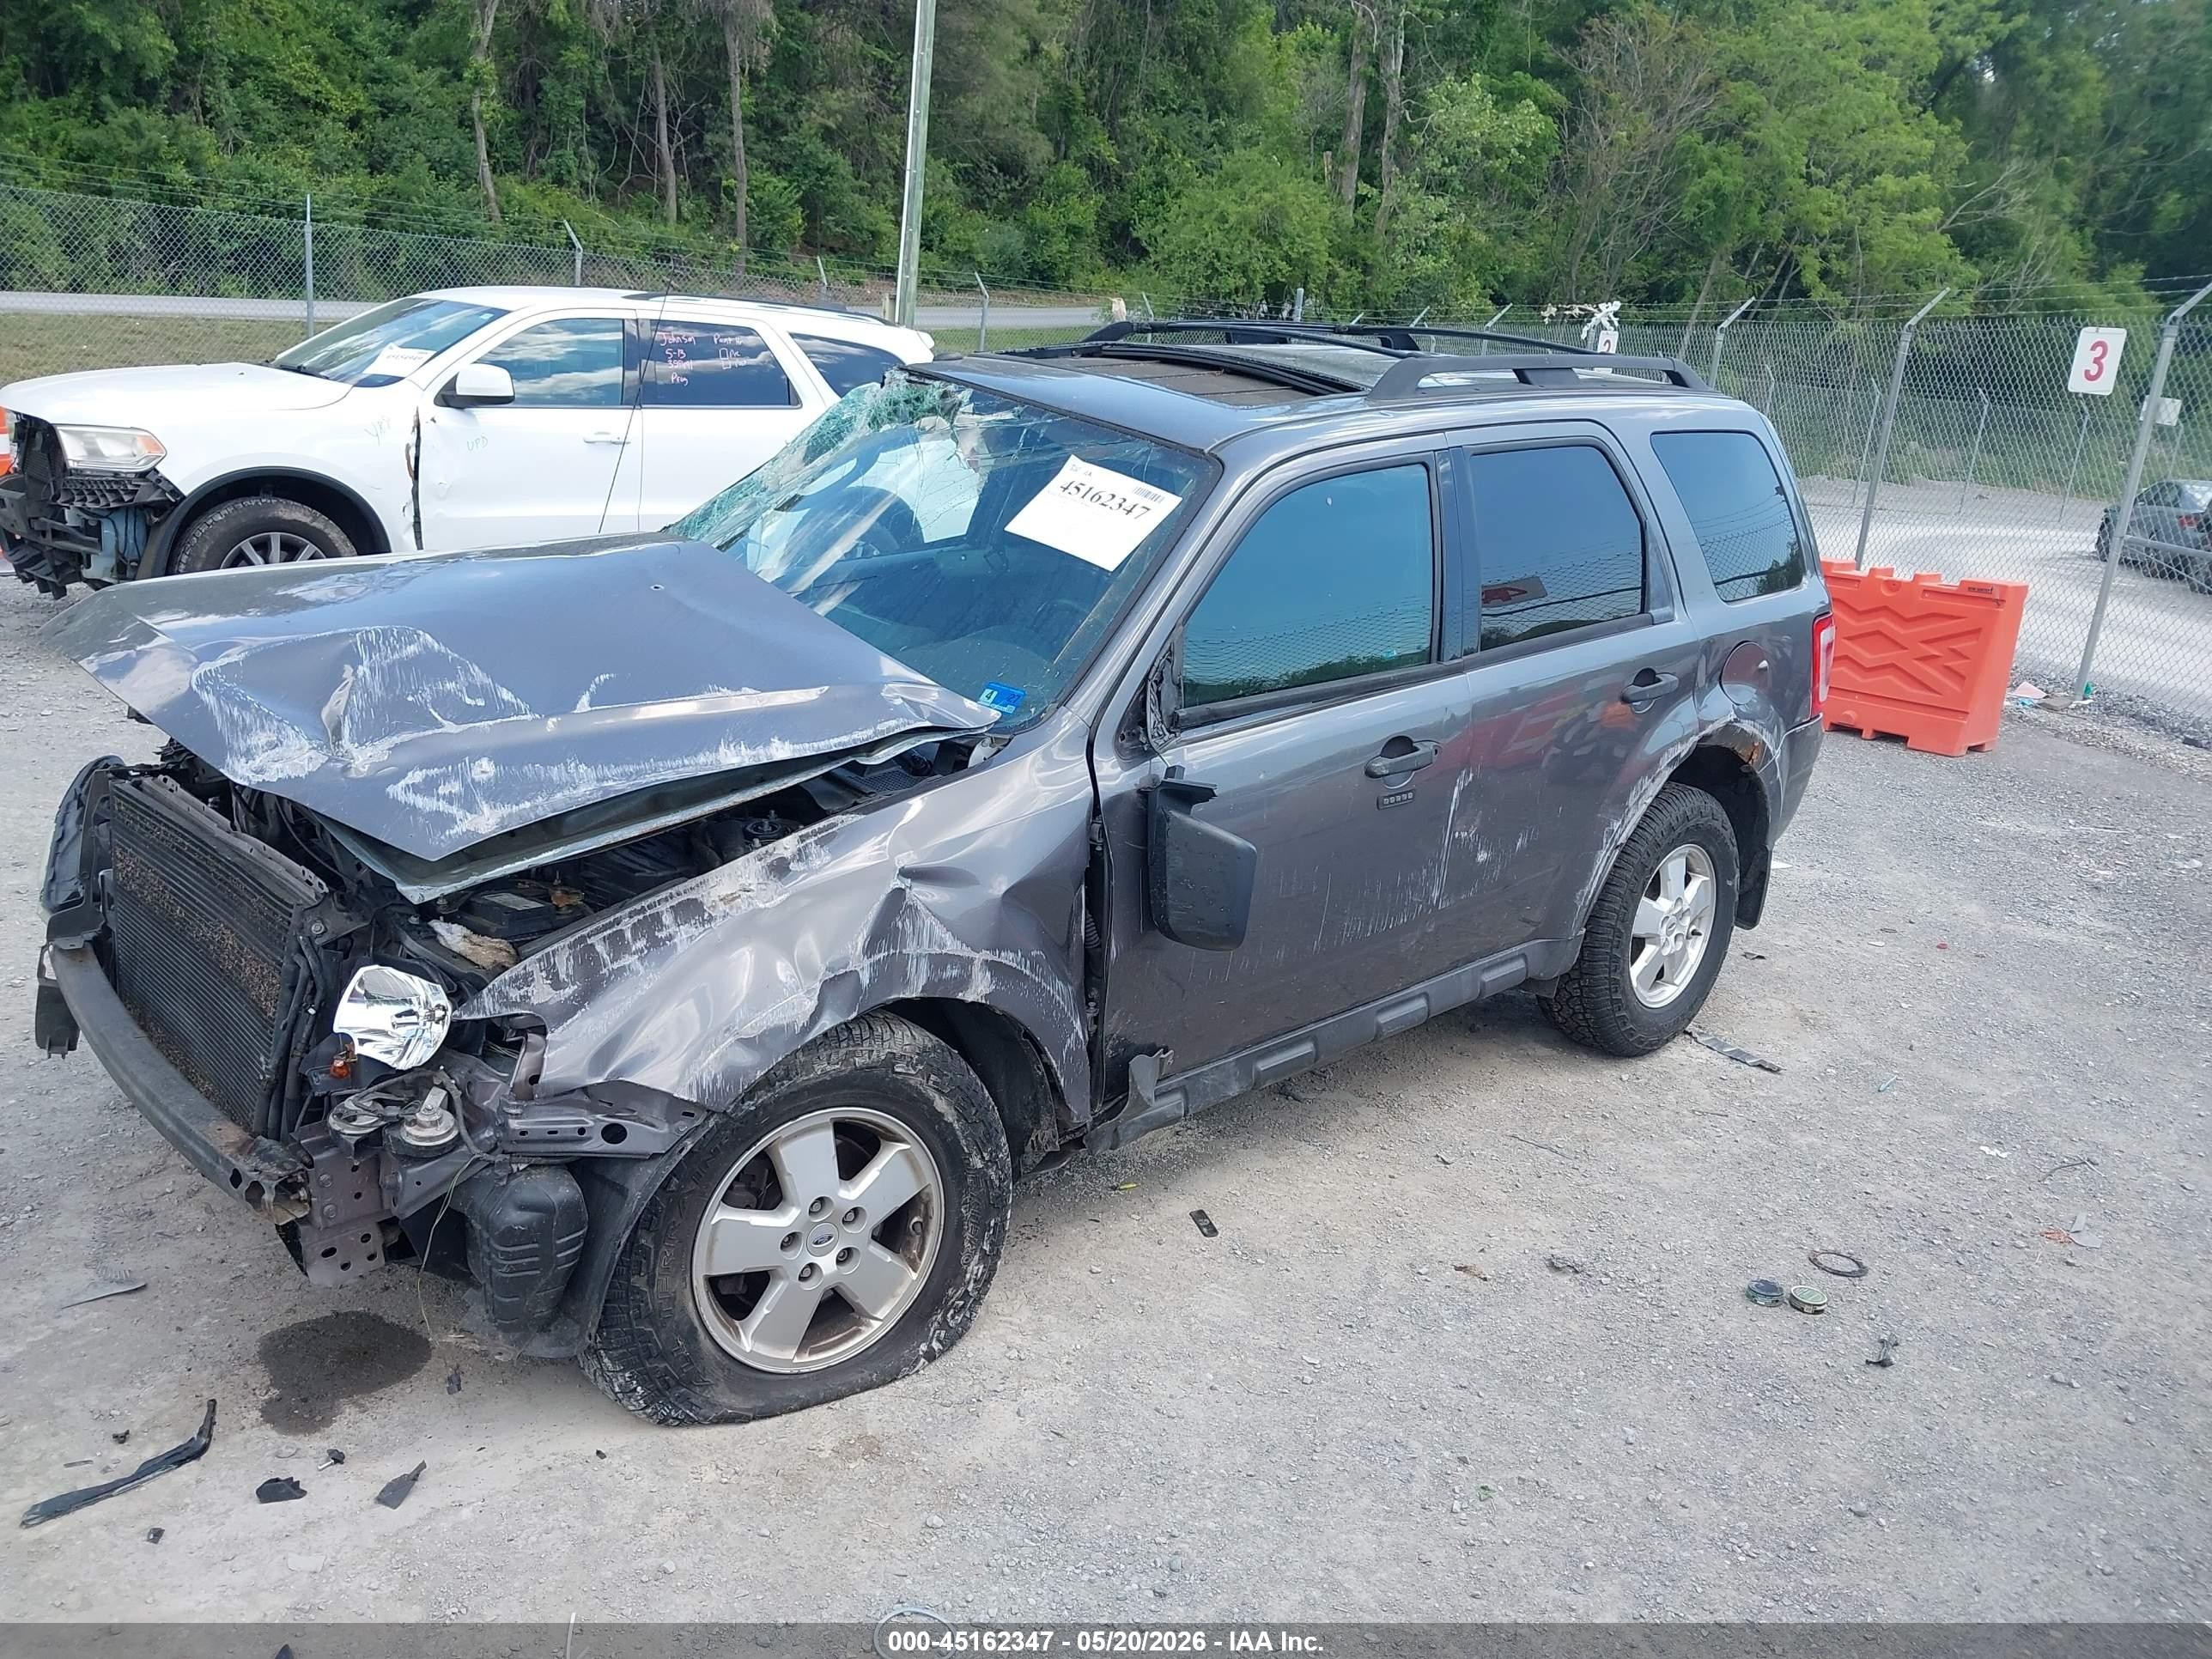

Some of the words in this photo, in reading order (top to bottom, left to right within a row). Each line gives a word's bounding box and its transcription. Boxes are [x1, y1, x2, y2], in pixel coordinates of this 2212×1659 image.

[659, 331, 696, 346] Johnson
[2084, 341, 2109, 382] 3
[1060, 479, 1152, 520] 45162347
[985, 690, 994, 701] 4
